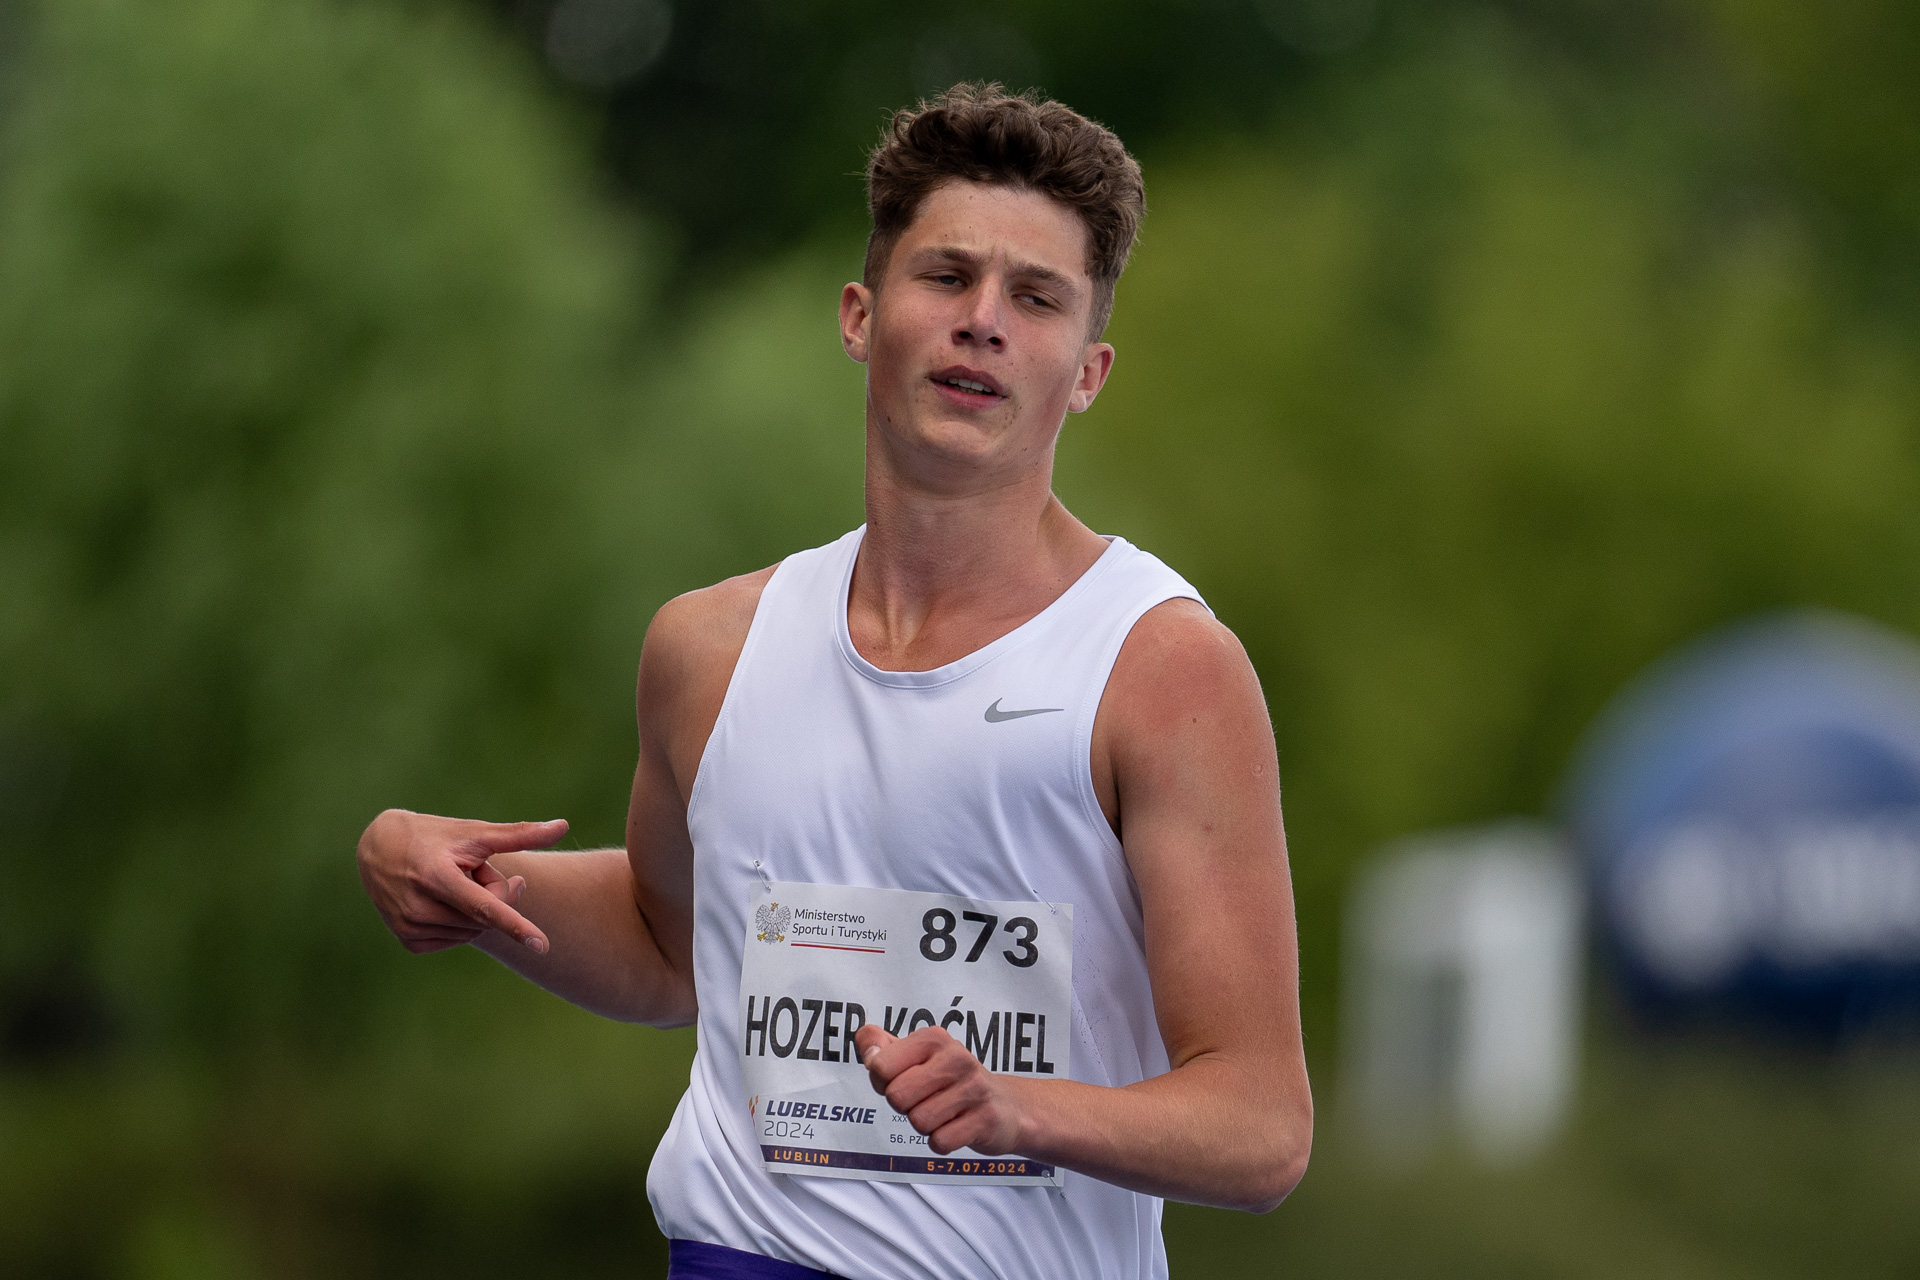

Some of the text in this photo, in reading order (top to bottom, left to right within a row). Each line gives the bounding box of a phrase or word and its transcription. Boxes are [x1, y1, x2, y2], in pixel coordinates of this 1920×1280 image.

[794, 908, 866, 924] Ministerstwo
[791, 923, 888, 942] Sportu i Turystyki
[919, 907, 1039, 968] 873
[745, 995, 867, 1065] HOZER
[765, 1100, 877, 1125] LUBELSKIE
[763, 1120, 815, 1140] 2024
[889, 1133, 929, 1145] 56. PZL
[774, 1149, 830, 1165] LUBLIN
[927, 1160, 1027, 1174] 5-7.07.2024
